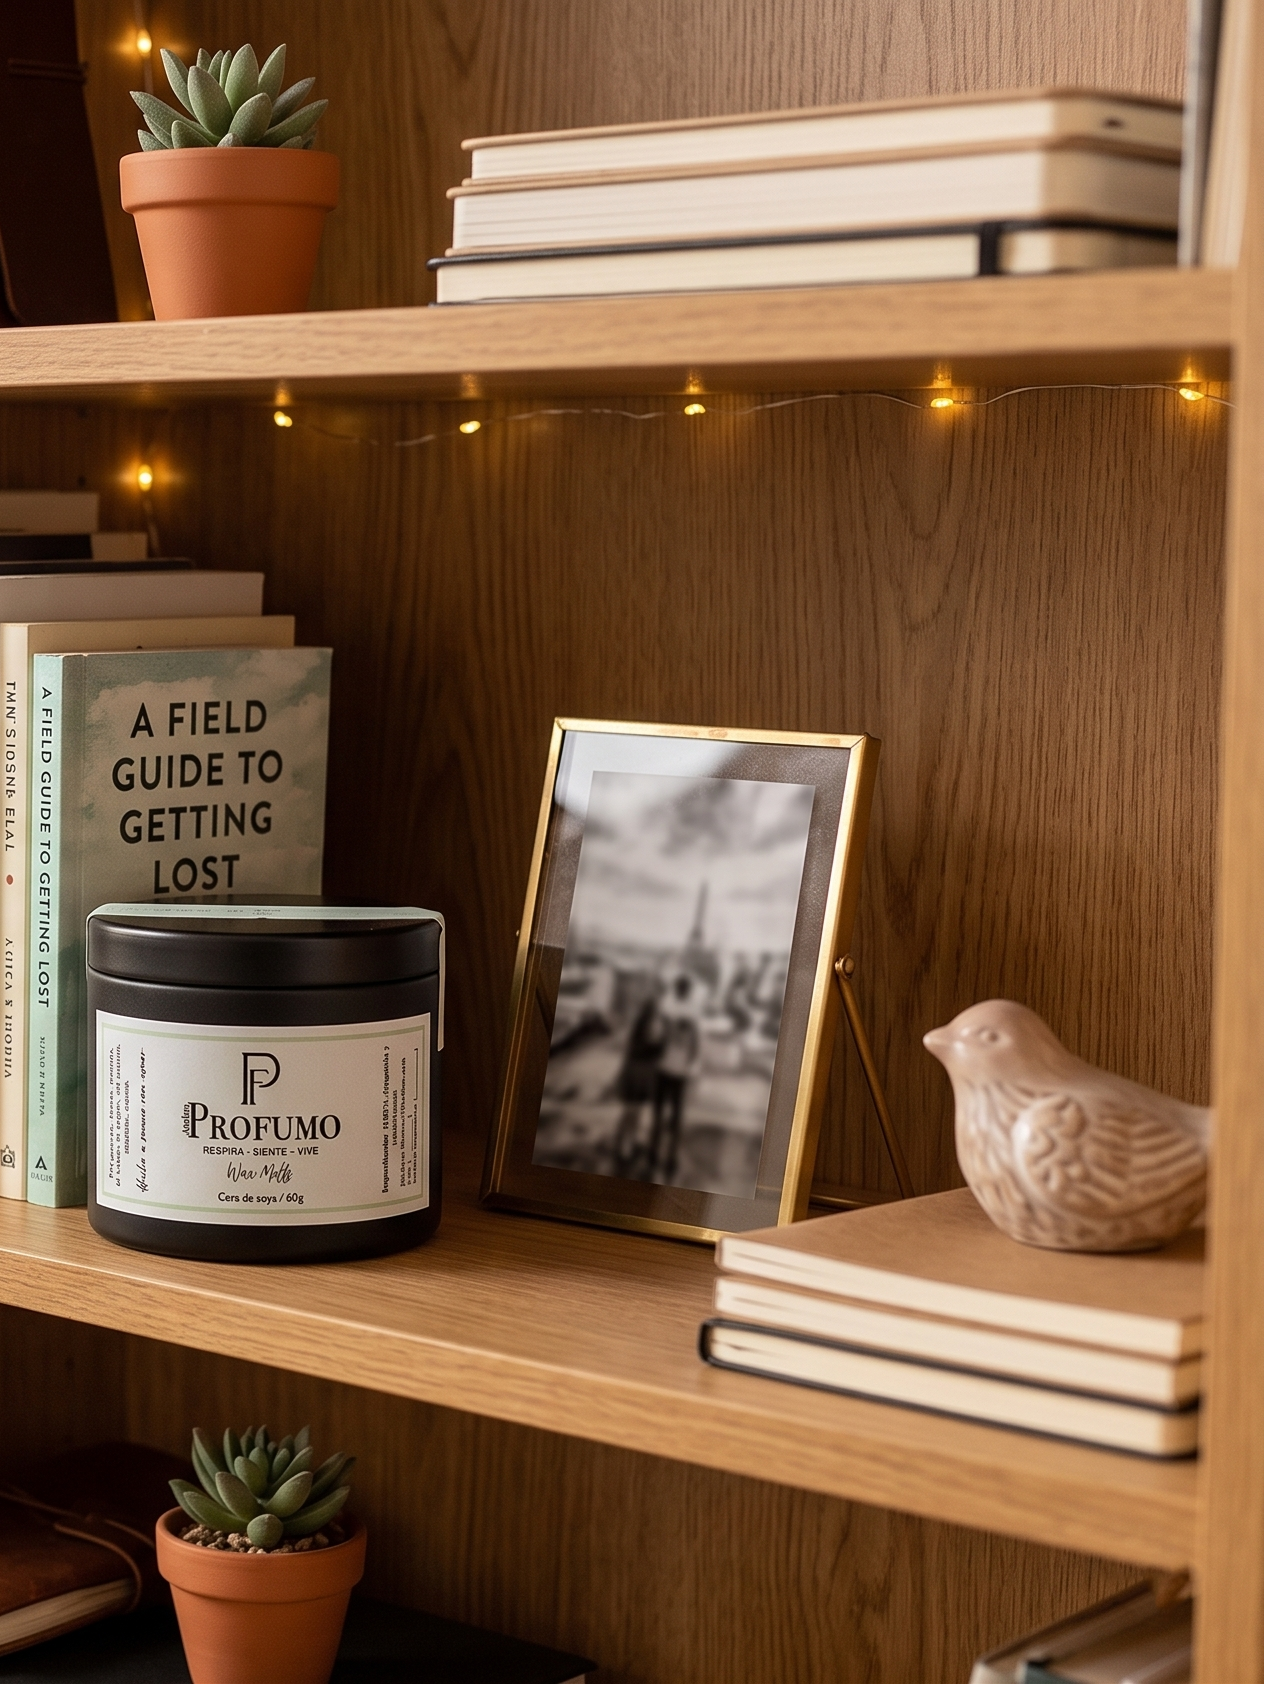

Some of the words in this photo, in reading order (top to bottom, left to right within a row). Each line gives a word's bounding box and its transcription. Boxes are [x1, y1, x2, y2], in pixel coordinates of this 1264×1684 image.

[42, 687, 52, 699] A
[42, 708, 52, 763] FIELD
[130, 703, 154, 738] A
[169, 700, 267, 736] FIELD
[112, 753, 223, 791] GUIDE
[238, 750, 282, 784] TO
[41, 772, 51, 833] GUIDE
[120, 801, 271, 844] GETTING
[40, 840, 50, 864] TO
[154, 854, 240, 894] LOST
[39, 873, 50, 952] GETTING
[39, 962, 49, 1007] LOST
[188, 1102, 341, 1140] PROFUMO
[204, 1146, 244, 1155] RESPIRA
[253, 1148, 287, 1156] SIENTE
[298, 1147, 318, 1155] VIVE
[242, 1193, 253, 1202] de
[257, 1196, 277, 1205] soya
[286, 1193, 303, 1204] 60g
